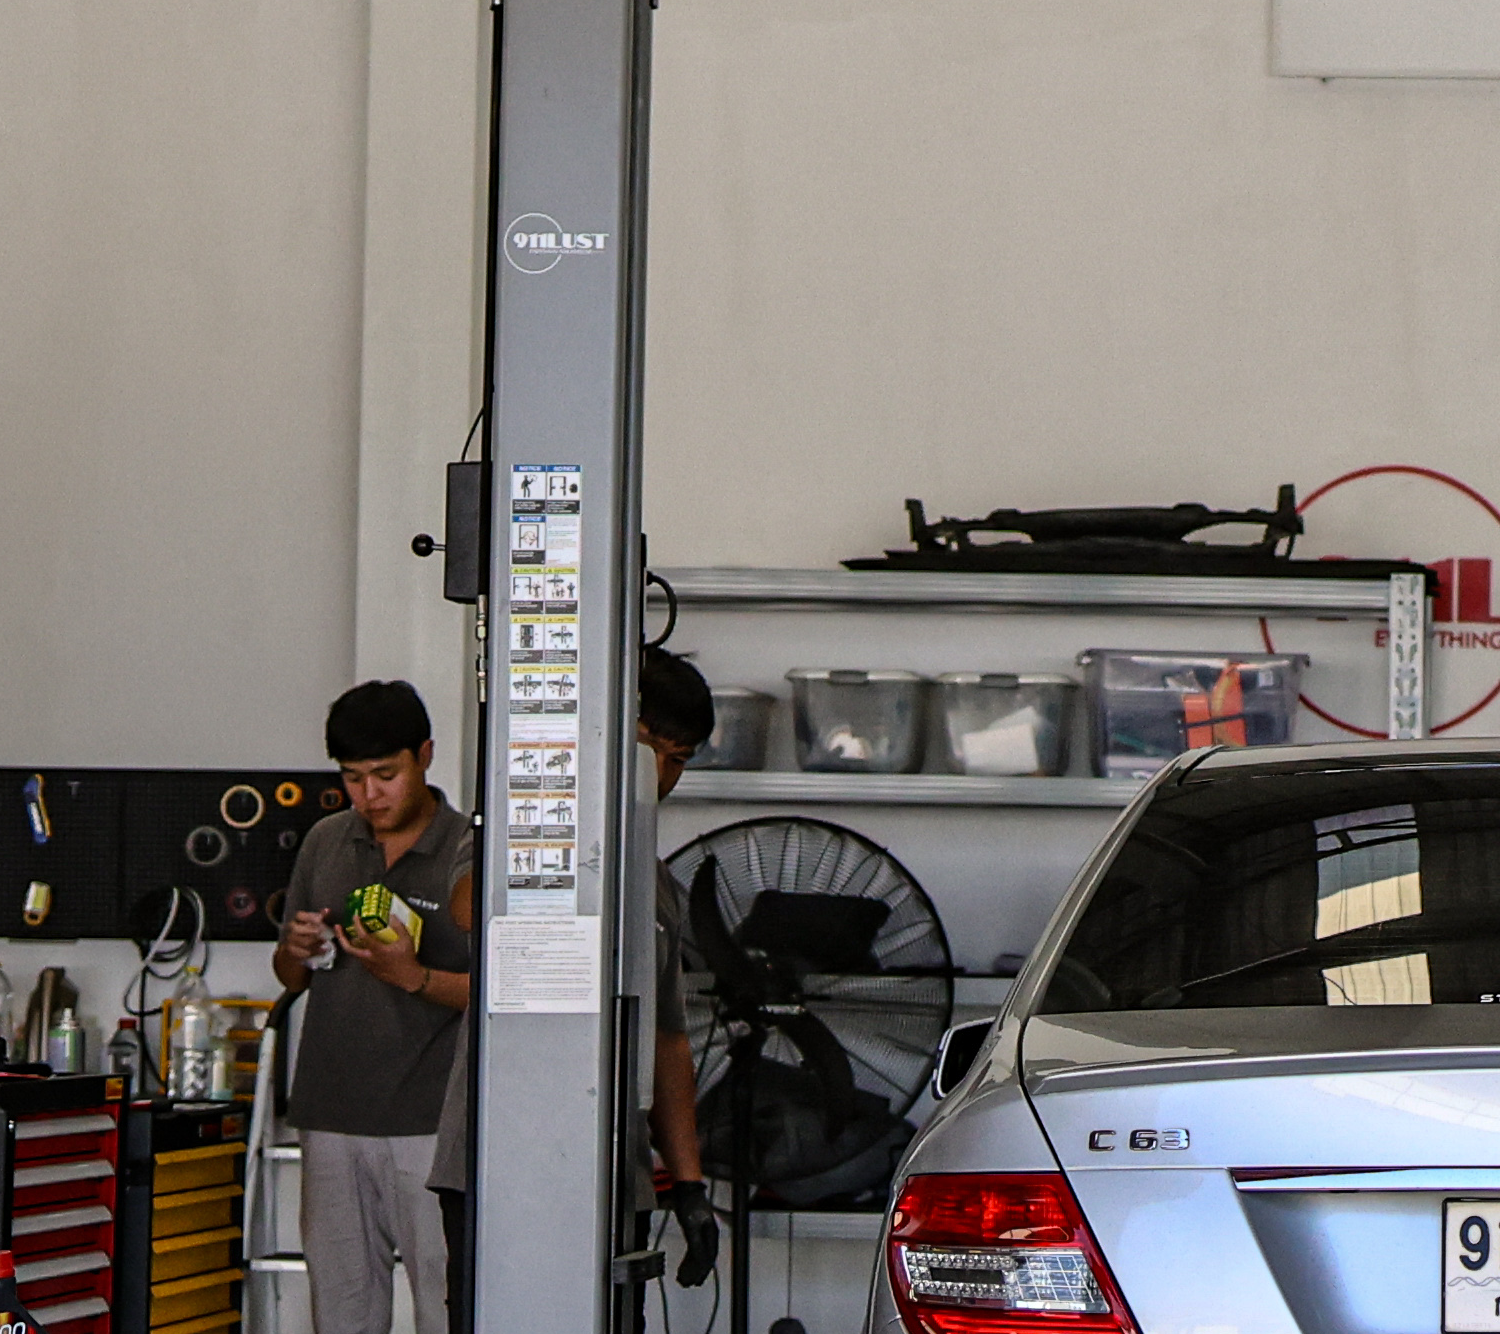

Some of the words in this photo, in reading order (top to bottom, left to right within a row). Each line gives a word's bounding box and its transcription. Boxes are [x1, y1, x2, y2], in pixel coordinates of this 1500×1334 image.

[513, 232, 609, 249] 911LUST
[1088, 1129, 1116, 1152] C
[1129, 1128, 1190, 1151] 63
